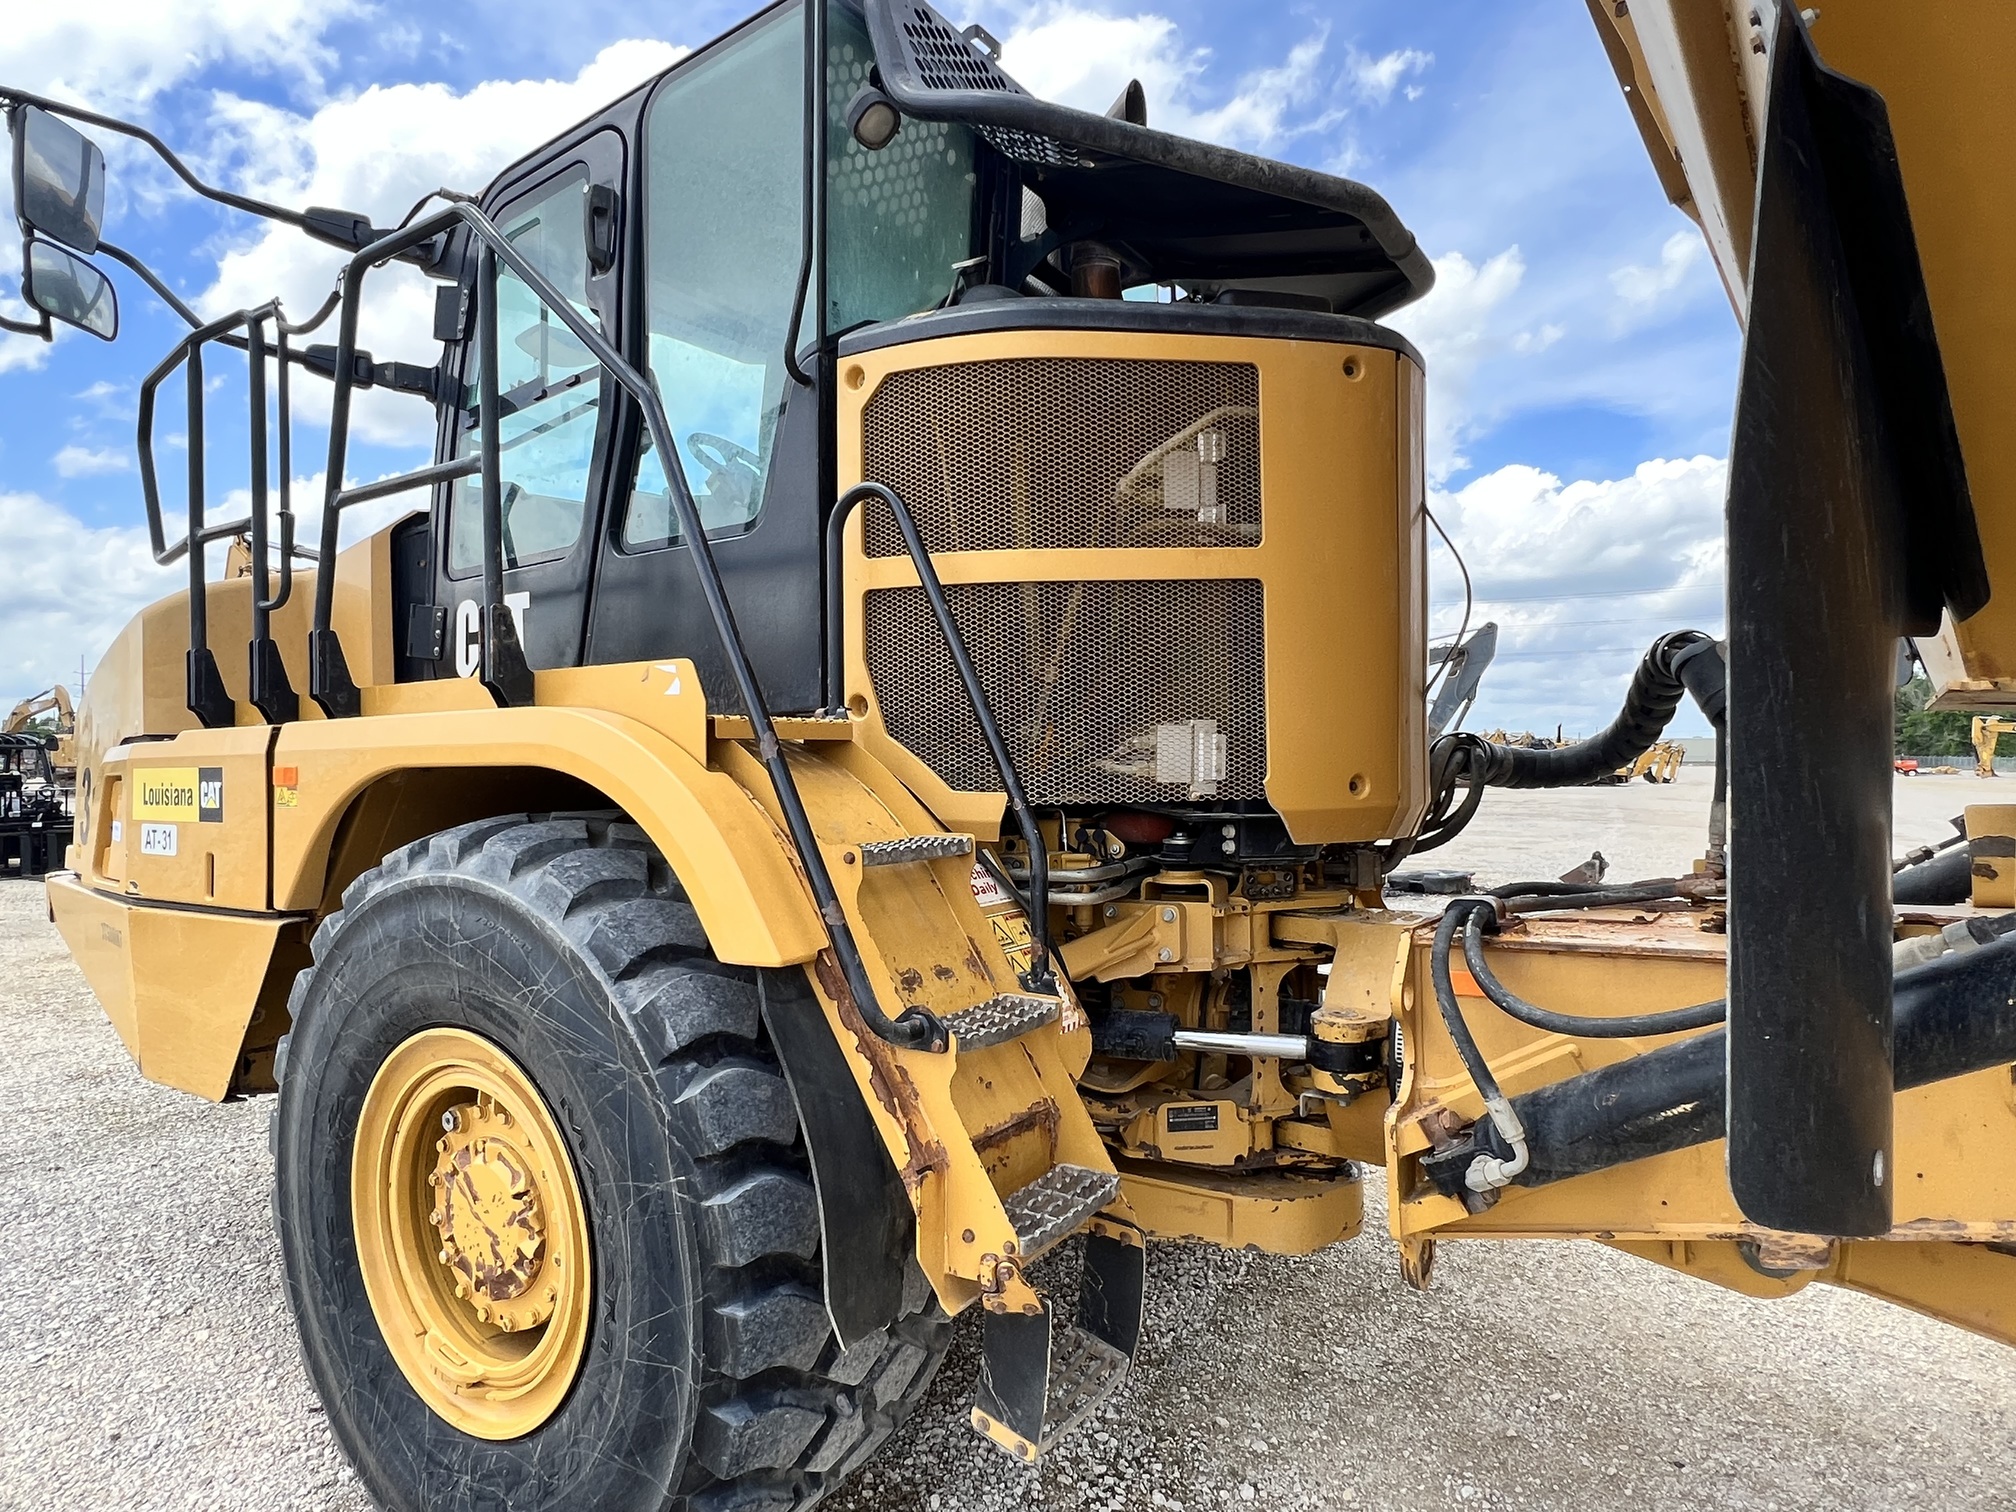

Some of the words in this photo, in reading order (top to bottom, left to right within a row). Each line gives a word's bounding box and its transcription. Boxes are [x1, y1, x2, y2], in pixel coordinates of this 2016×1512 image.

[456, 591, 531, 678] CT
[143, 782, 193, 806] Louisiana
[200, 781, 222, 809] CAT
[144, 829, 172, 851] AT-31
[971, 881, 998, 896] Daily
